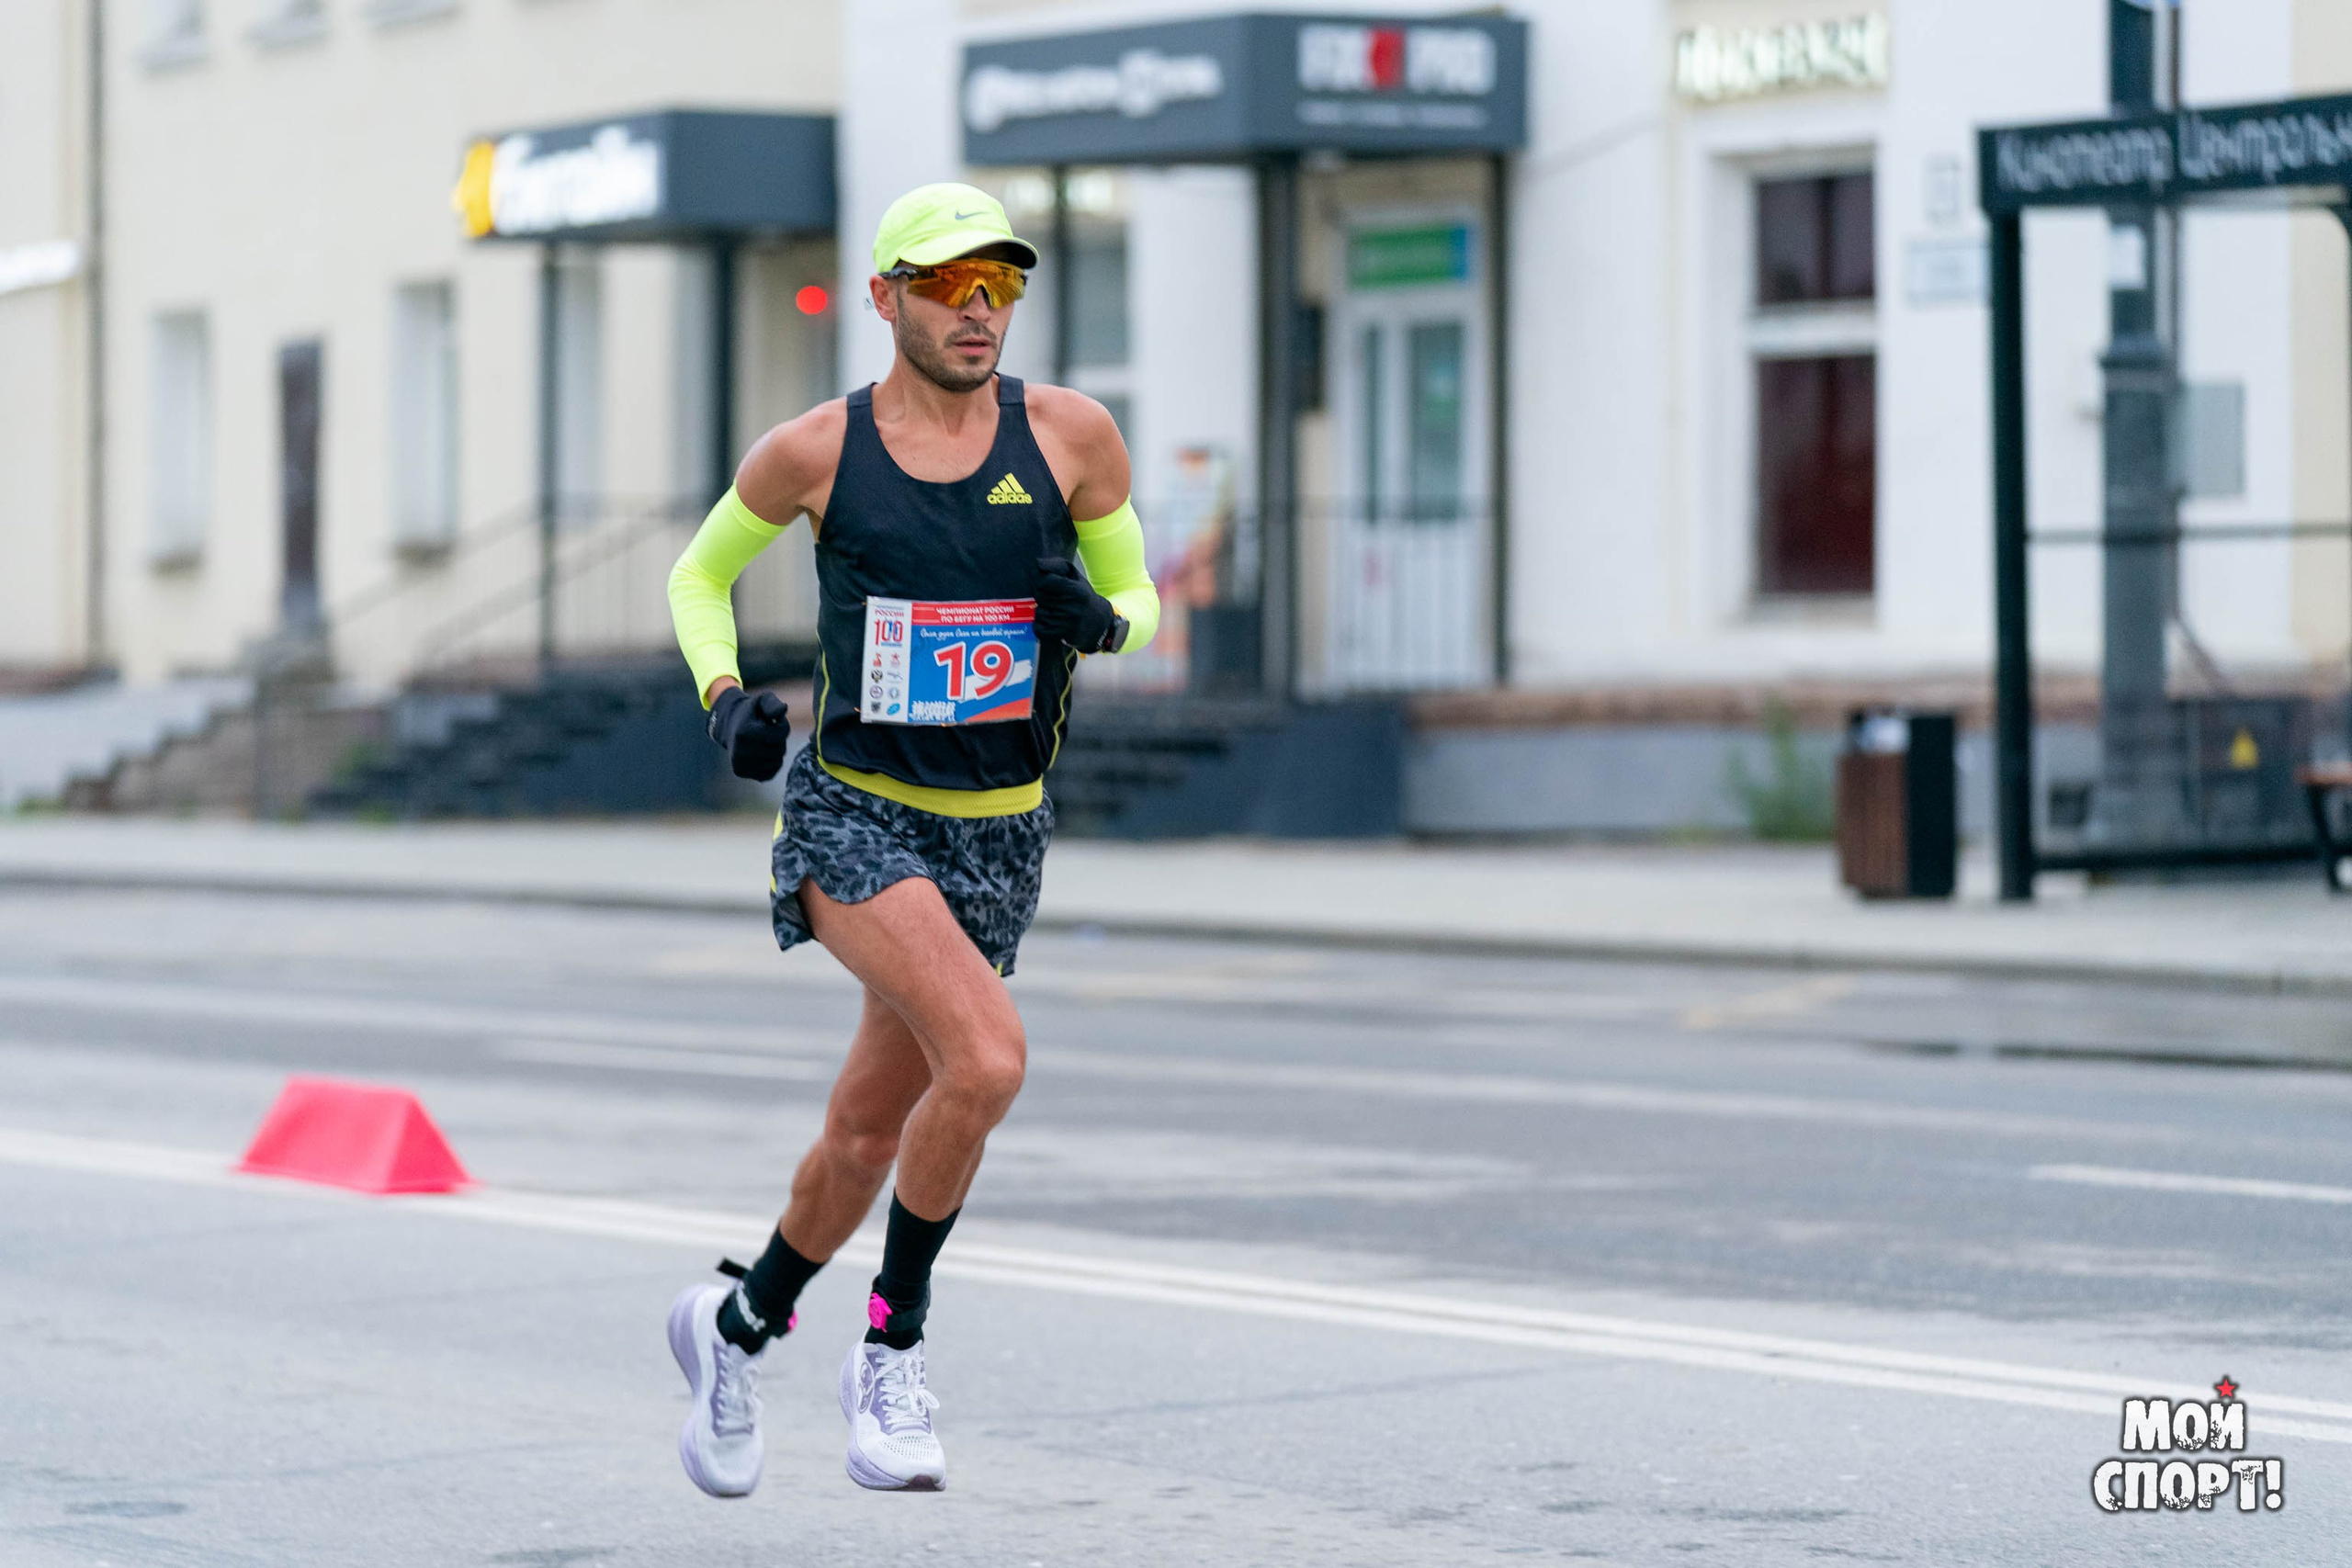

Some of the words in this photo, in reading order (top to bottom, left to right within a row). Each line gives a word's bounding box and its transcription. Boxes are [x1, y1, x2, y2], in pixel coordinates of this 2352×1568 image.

[987, 492, 1033, 505] adidas
[936, 606, 984, 615] ЧЕМПИОНАТ
[934, 641, 1014, 701] 19
